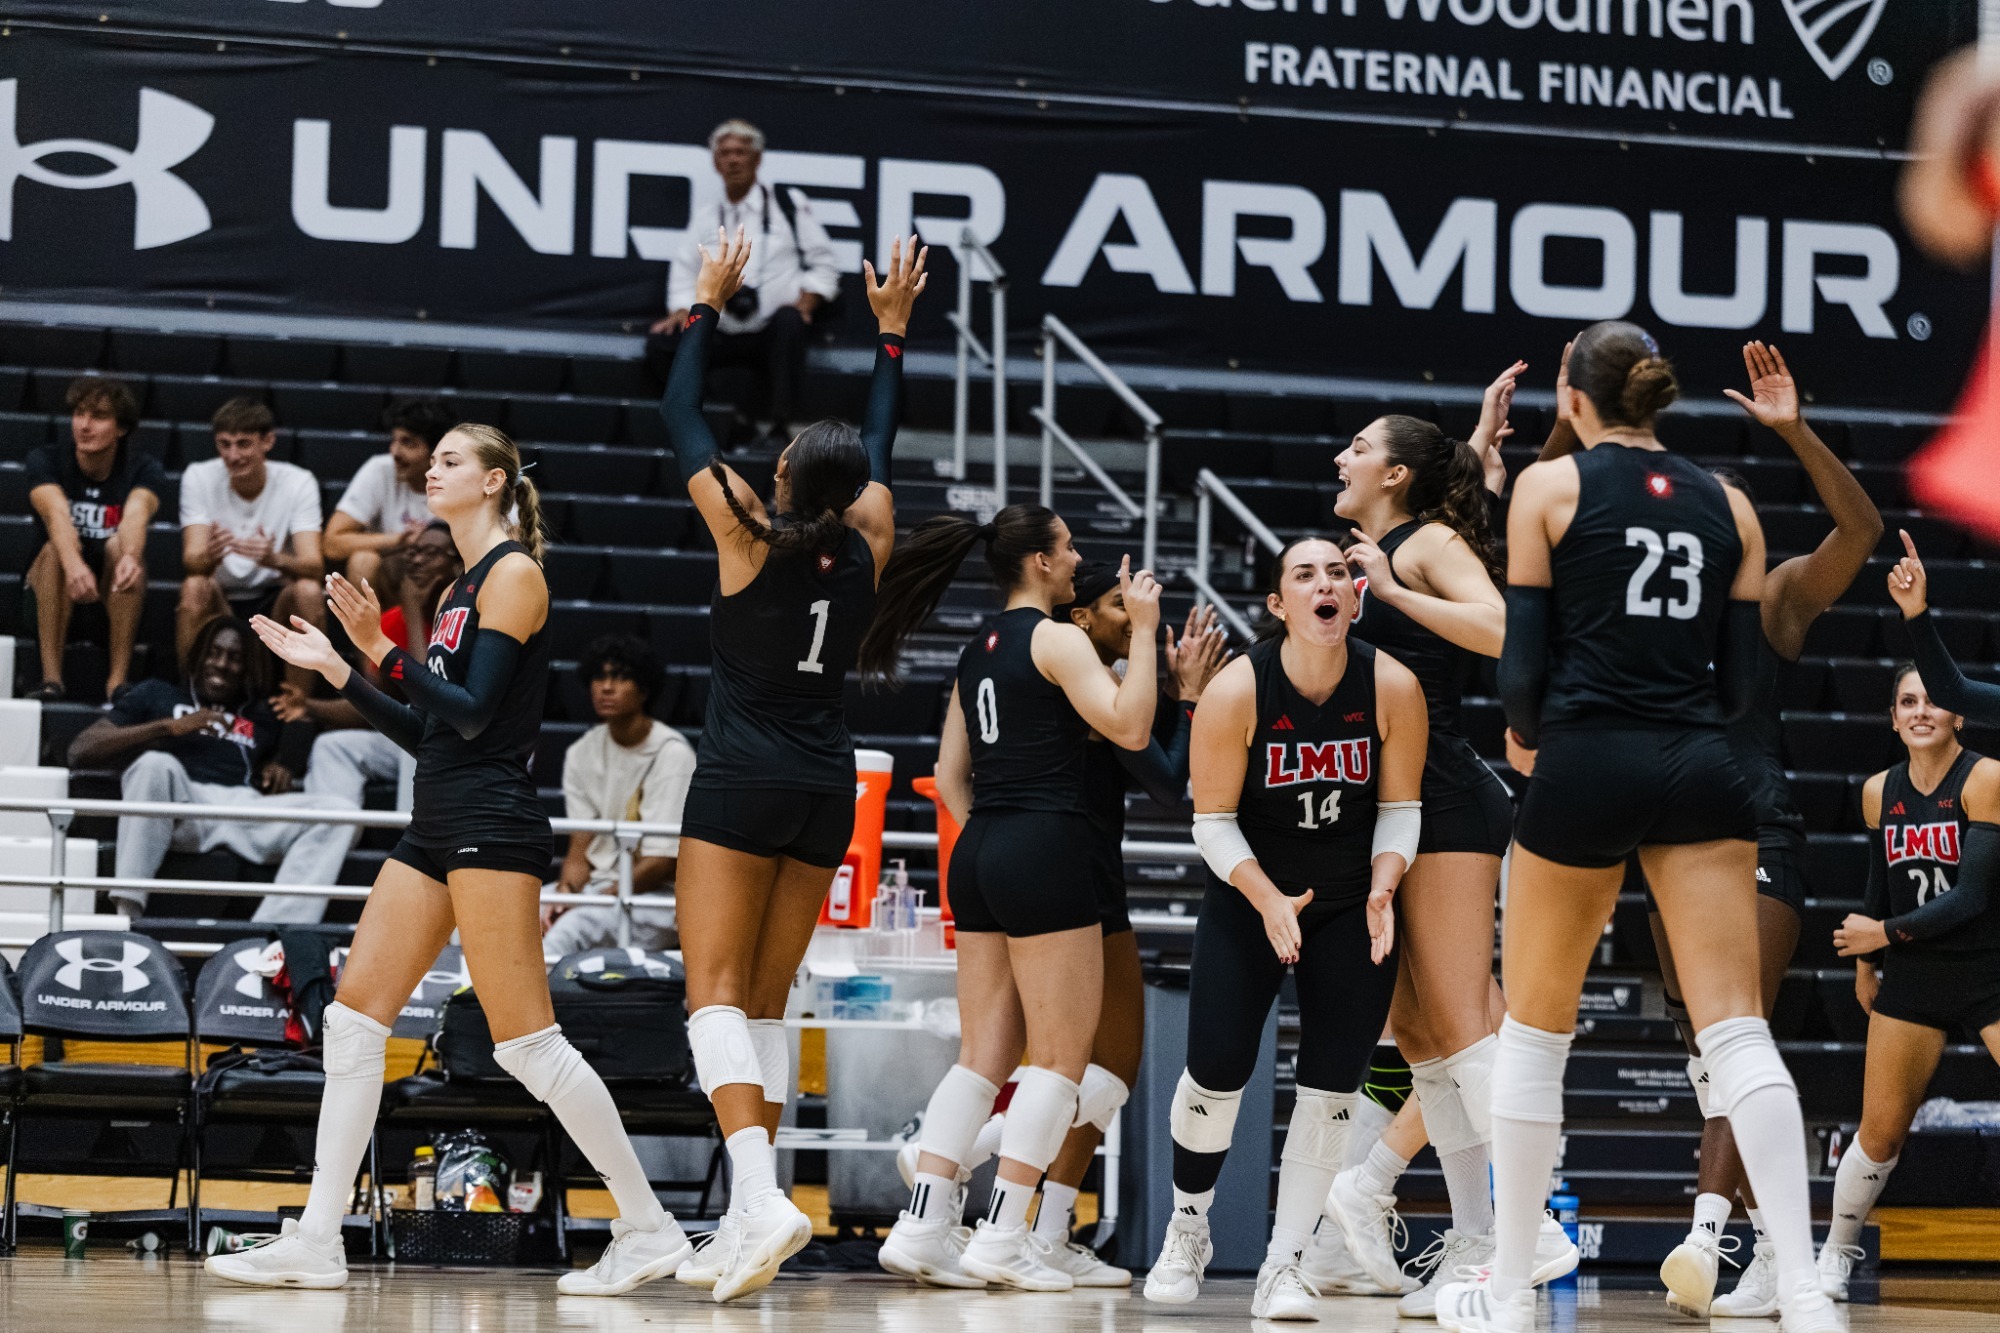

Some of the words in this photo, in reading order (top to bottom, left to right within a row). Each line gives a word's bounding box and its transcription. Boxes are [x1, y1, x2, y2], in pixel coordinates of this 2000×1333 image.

[1244, 40, 1525, 101] FRATERNAL
[1538, 60, 1796, 121] FINANCIAL
[1040, 171, 1902, 340] ARMOUR
[1625, 526, 1704, 620] 23
[797, 599, 831, 675] 1
[976, 677, 999, 745] 0
[1264, 736, 1371, 789] LMU
[1297, 789, 1342, 829] 14
[1884, 820, 1960, 868] LMU
[37, 993, 93, 1010] UNDER
[95, 999, 168, 1012] ARMOUR
[219, 1004, 275, 1018] UNDER
